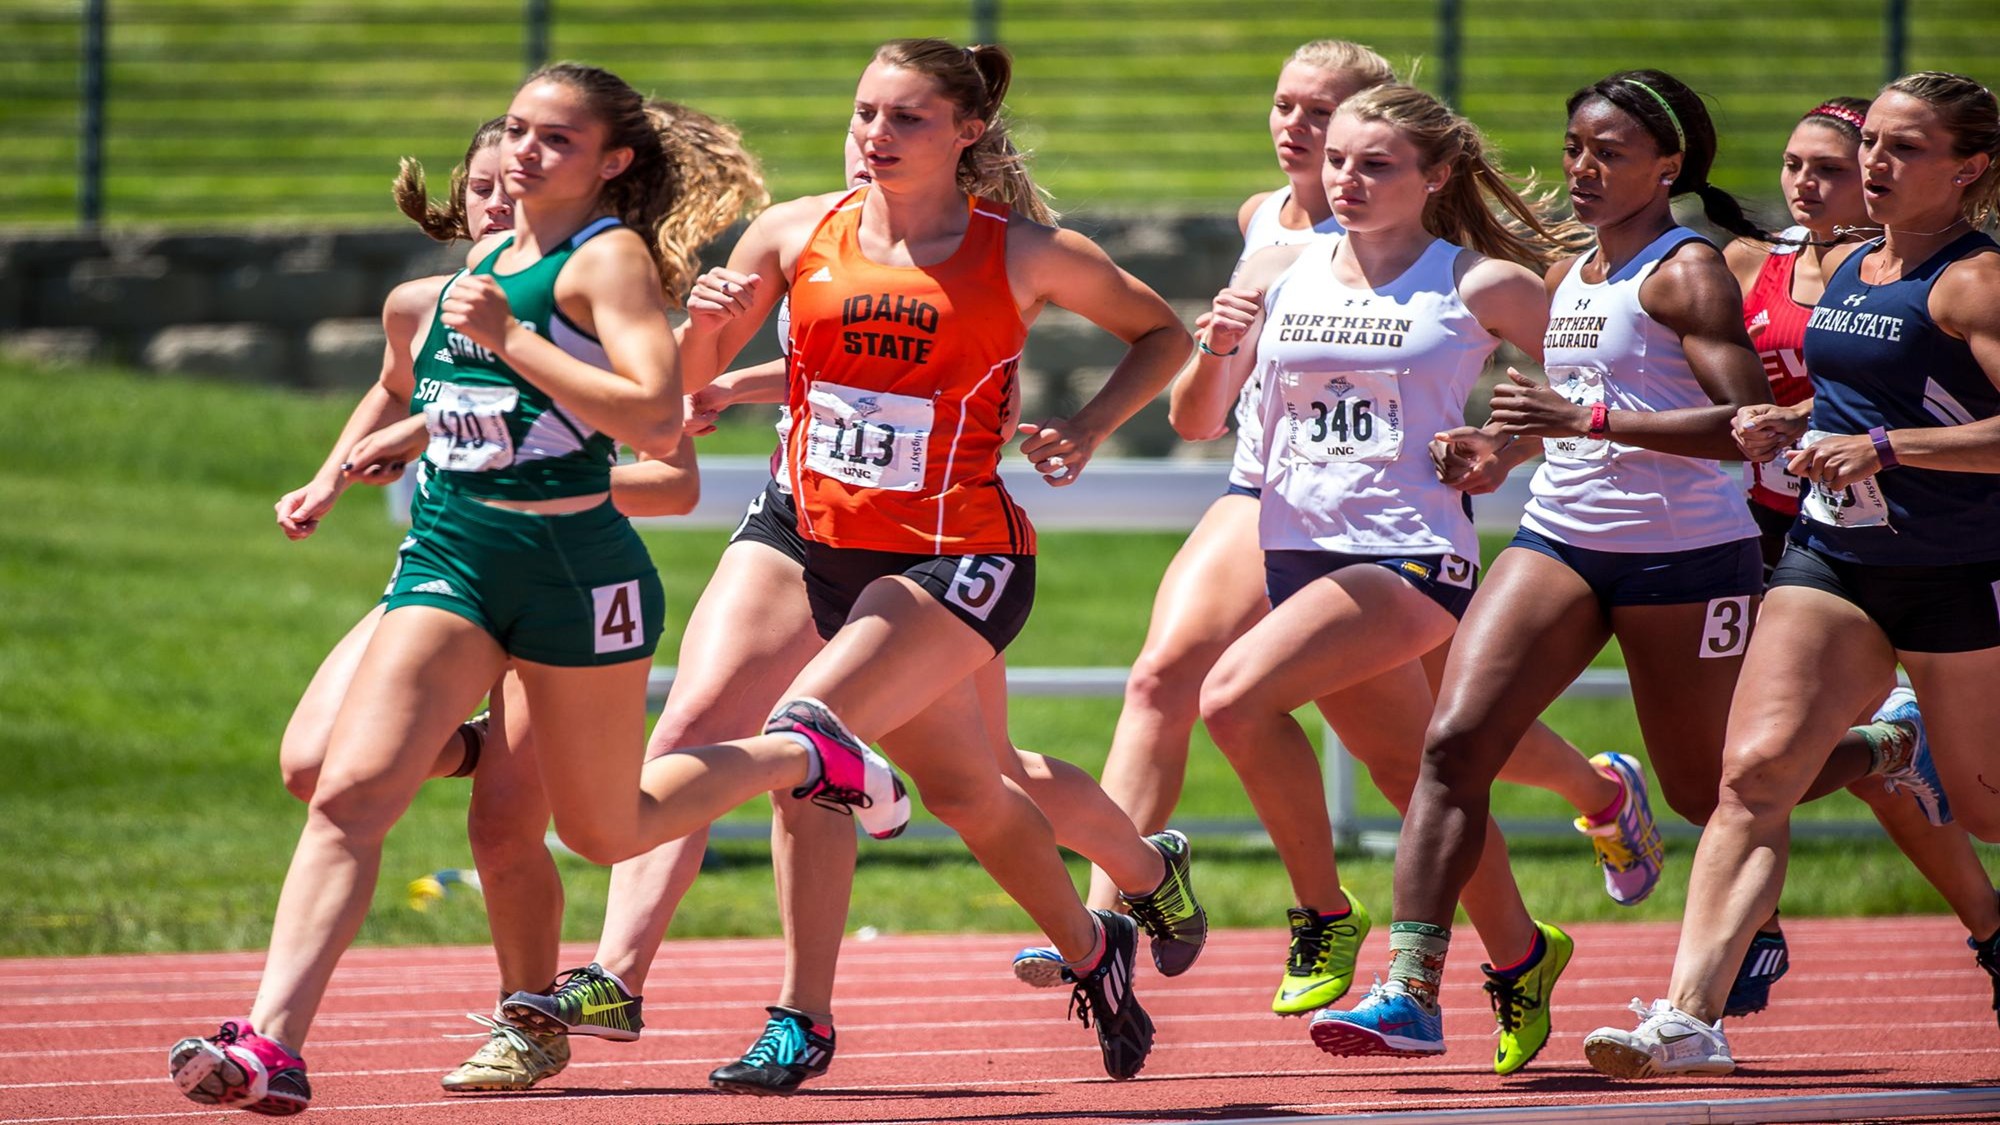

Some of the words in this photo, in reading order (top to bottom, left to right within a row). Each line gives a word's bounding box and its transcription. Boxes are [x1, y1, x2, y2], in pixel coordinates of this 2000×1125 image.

[842, 293, 939, 334] IDAHO
[1280, 313, 1413, 332] NORTHERN
[1549, 316, 1608, 331] ORTHERN
[1849, 312, 1904, 342] STATE
[843, 331, 933, 365] STATE
[1279, 328, 1404, 348] COLORADO
[1287, 401, 1299, 445] #BigSkyTF
[1311, 400, 1373, 442] 346
[1388, 399, 1399, 442] #BigSkyTF
[830, 417, 895, 467] 113
[1327, 446, 1354, 456] UNC
[843, 467, 872, 479] UNC
[957, 554, 1006, 608] 5
[601, 586, 636, 645] 4
[1708, 600, 1742, 654] 3
